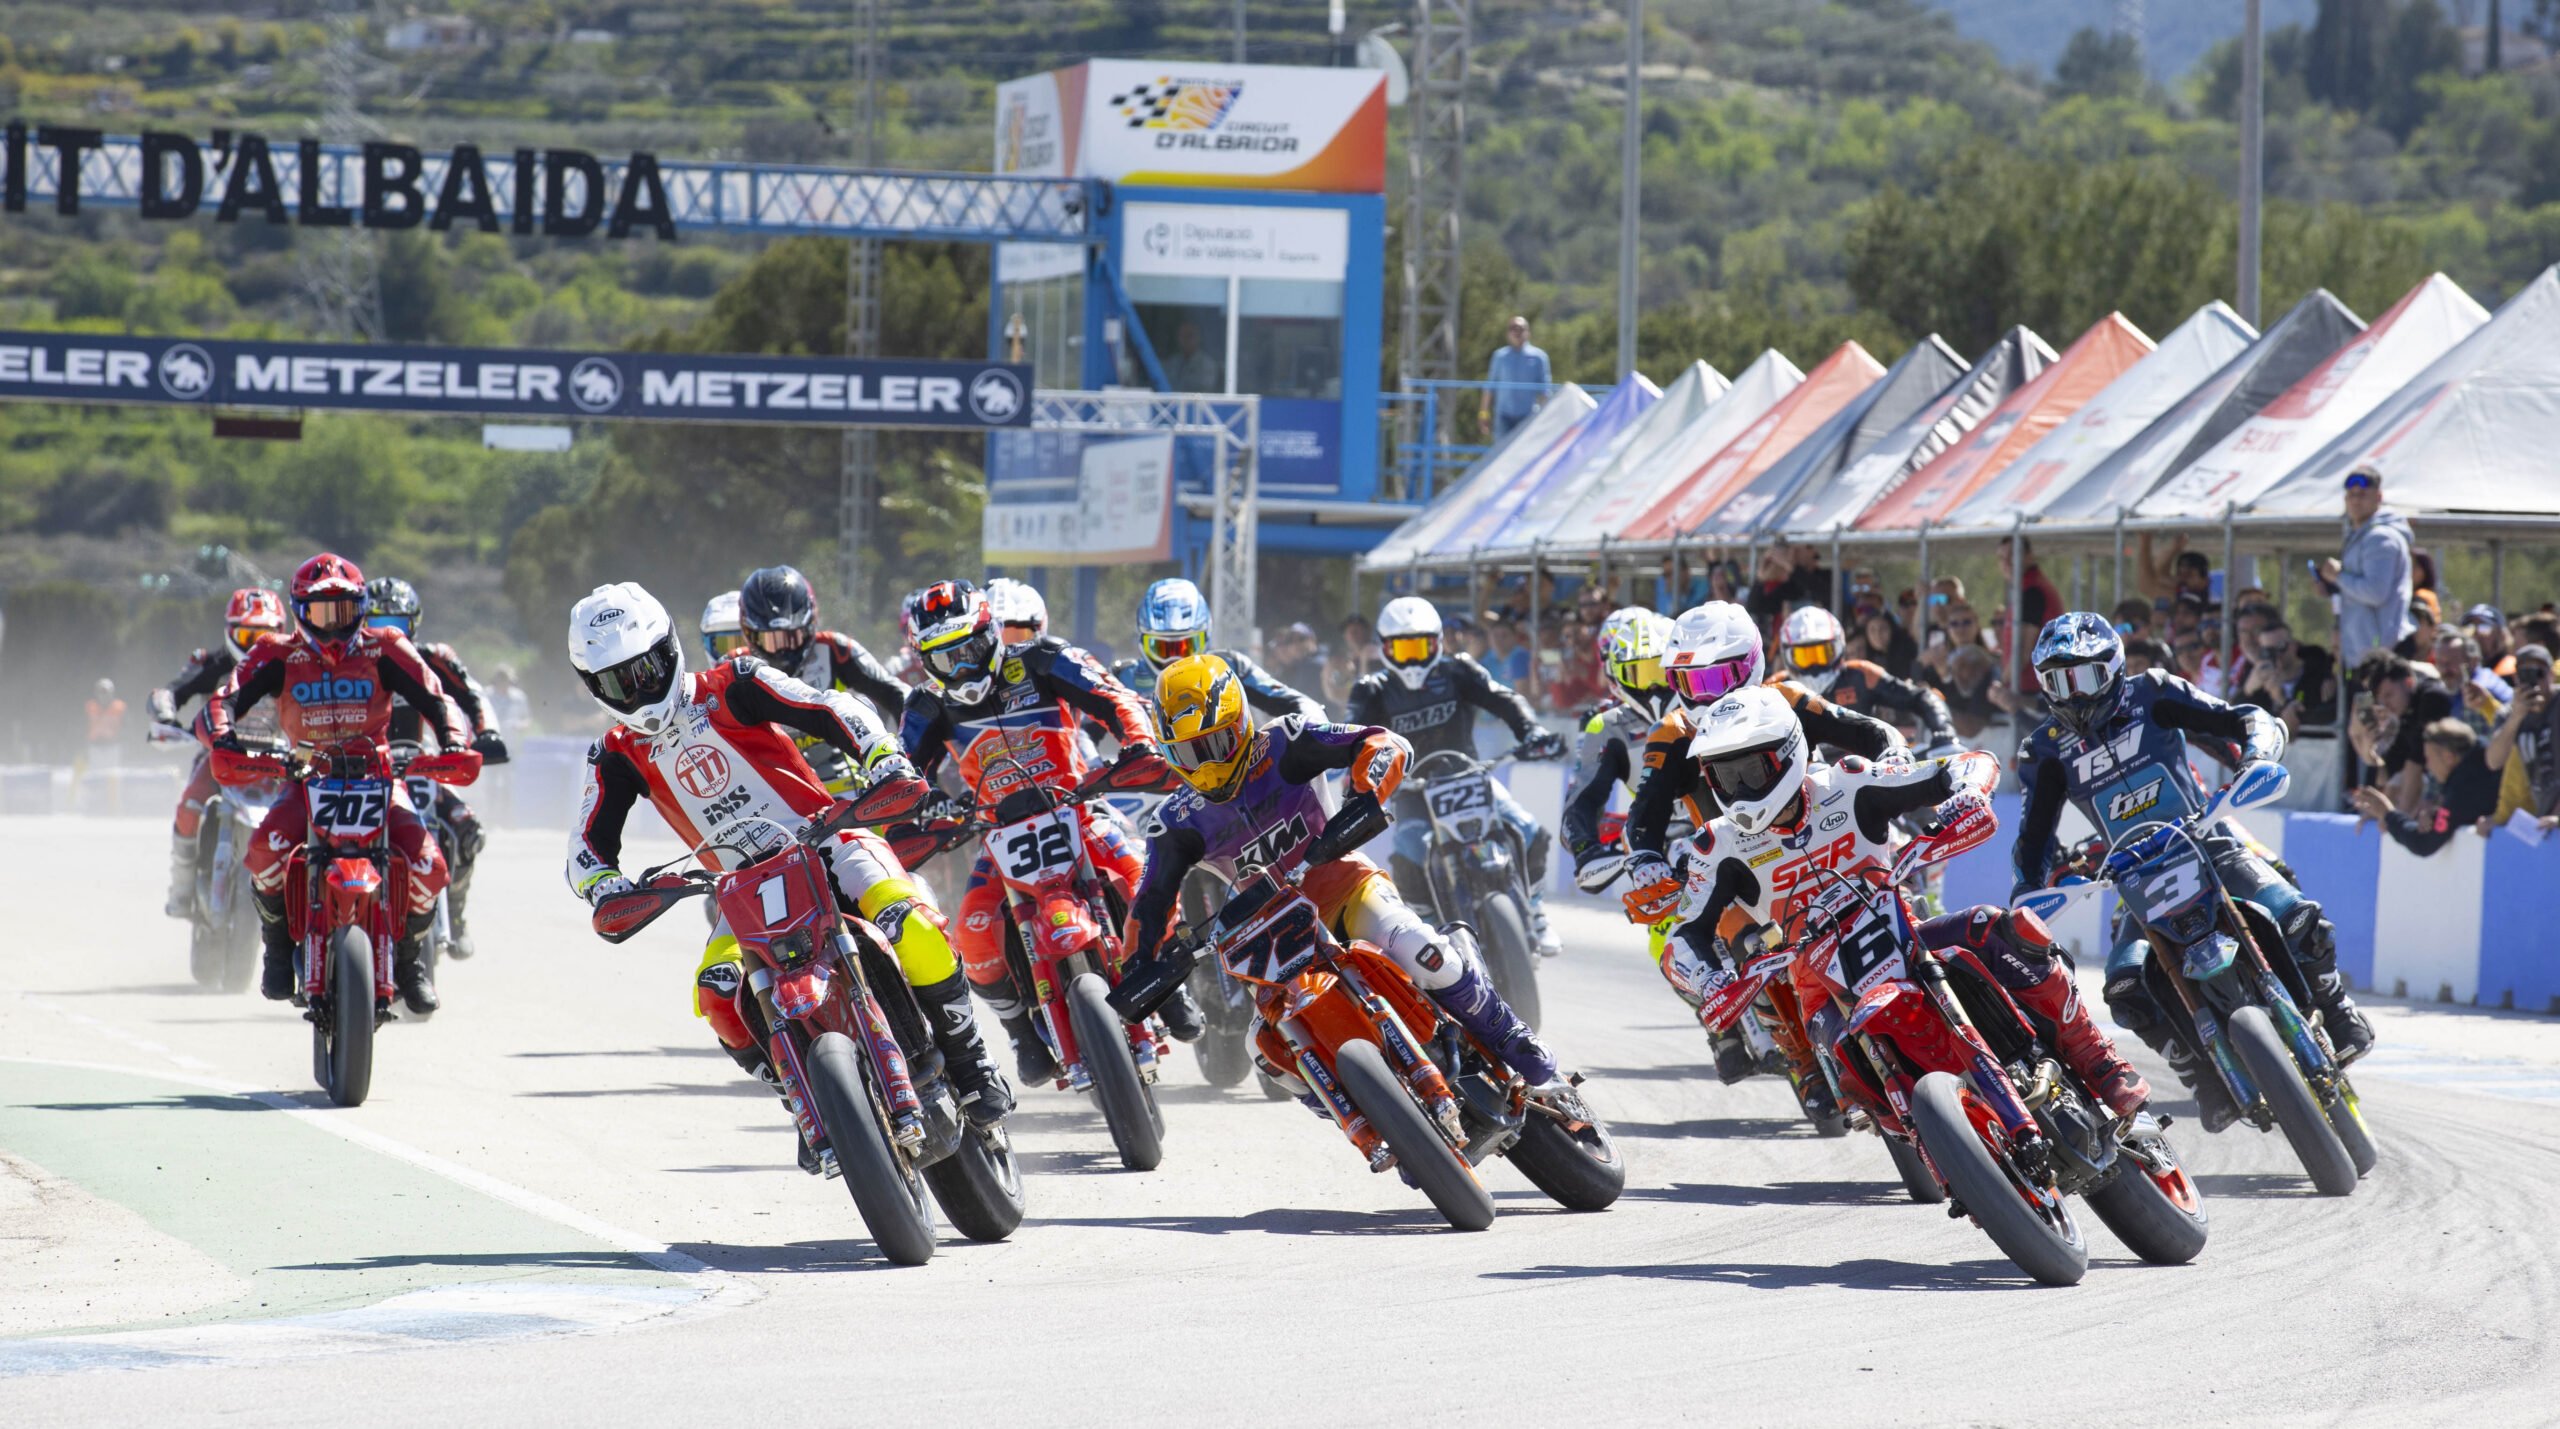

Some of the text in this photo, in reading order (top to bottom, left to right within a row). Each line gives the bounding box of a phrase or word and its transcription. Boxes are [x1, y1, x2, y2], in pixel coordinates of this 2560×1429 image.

[141, 128, 677, 241] D'ALBAIDA
[235, 352, 562, 402] METZELER
[641, 369, 962, 413] METZELER
[291, 671, 374, 704] orion
[301, 714, 368, 727] NEDVED
[690, 718, 710, 739] FIM
[680, 748, 706, 767] TEAM
[701, 777, 726, 795] UNDICI
[987, 759, 1056, 792] HONDA
[2236, 775, 2267, 804] CIRCUIT
[314, 793, 384, 827] 202
[1822, 812, 1847, 830] Arai
[1955, 809, 1989, 834] MOTUL
[1007, 822, 1073, 878] 32
[1232, 811, 1311, 882] KTM
[1949, 818, 1996, 849] POLISPORT
[755, 873, 790, 928] 1
[2031, 896, 2061, 913] IRCUIT
[2144, 858, 2202, 923] 3
[612, 899, 654, 920] CIRCUIT
[1228, 902, 1316, 979] 72
[1841, 915, 1897, 987] 6
[1857, 957, 1901, 993] HONDA
[1700, 993, 1729, 1019] MOTUL
[1720, 977, 1762, 1021] POLISPORT
[1303, 1050, 1347, 1105] METZER
